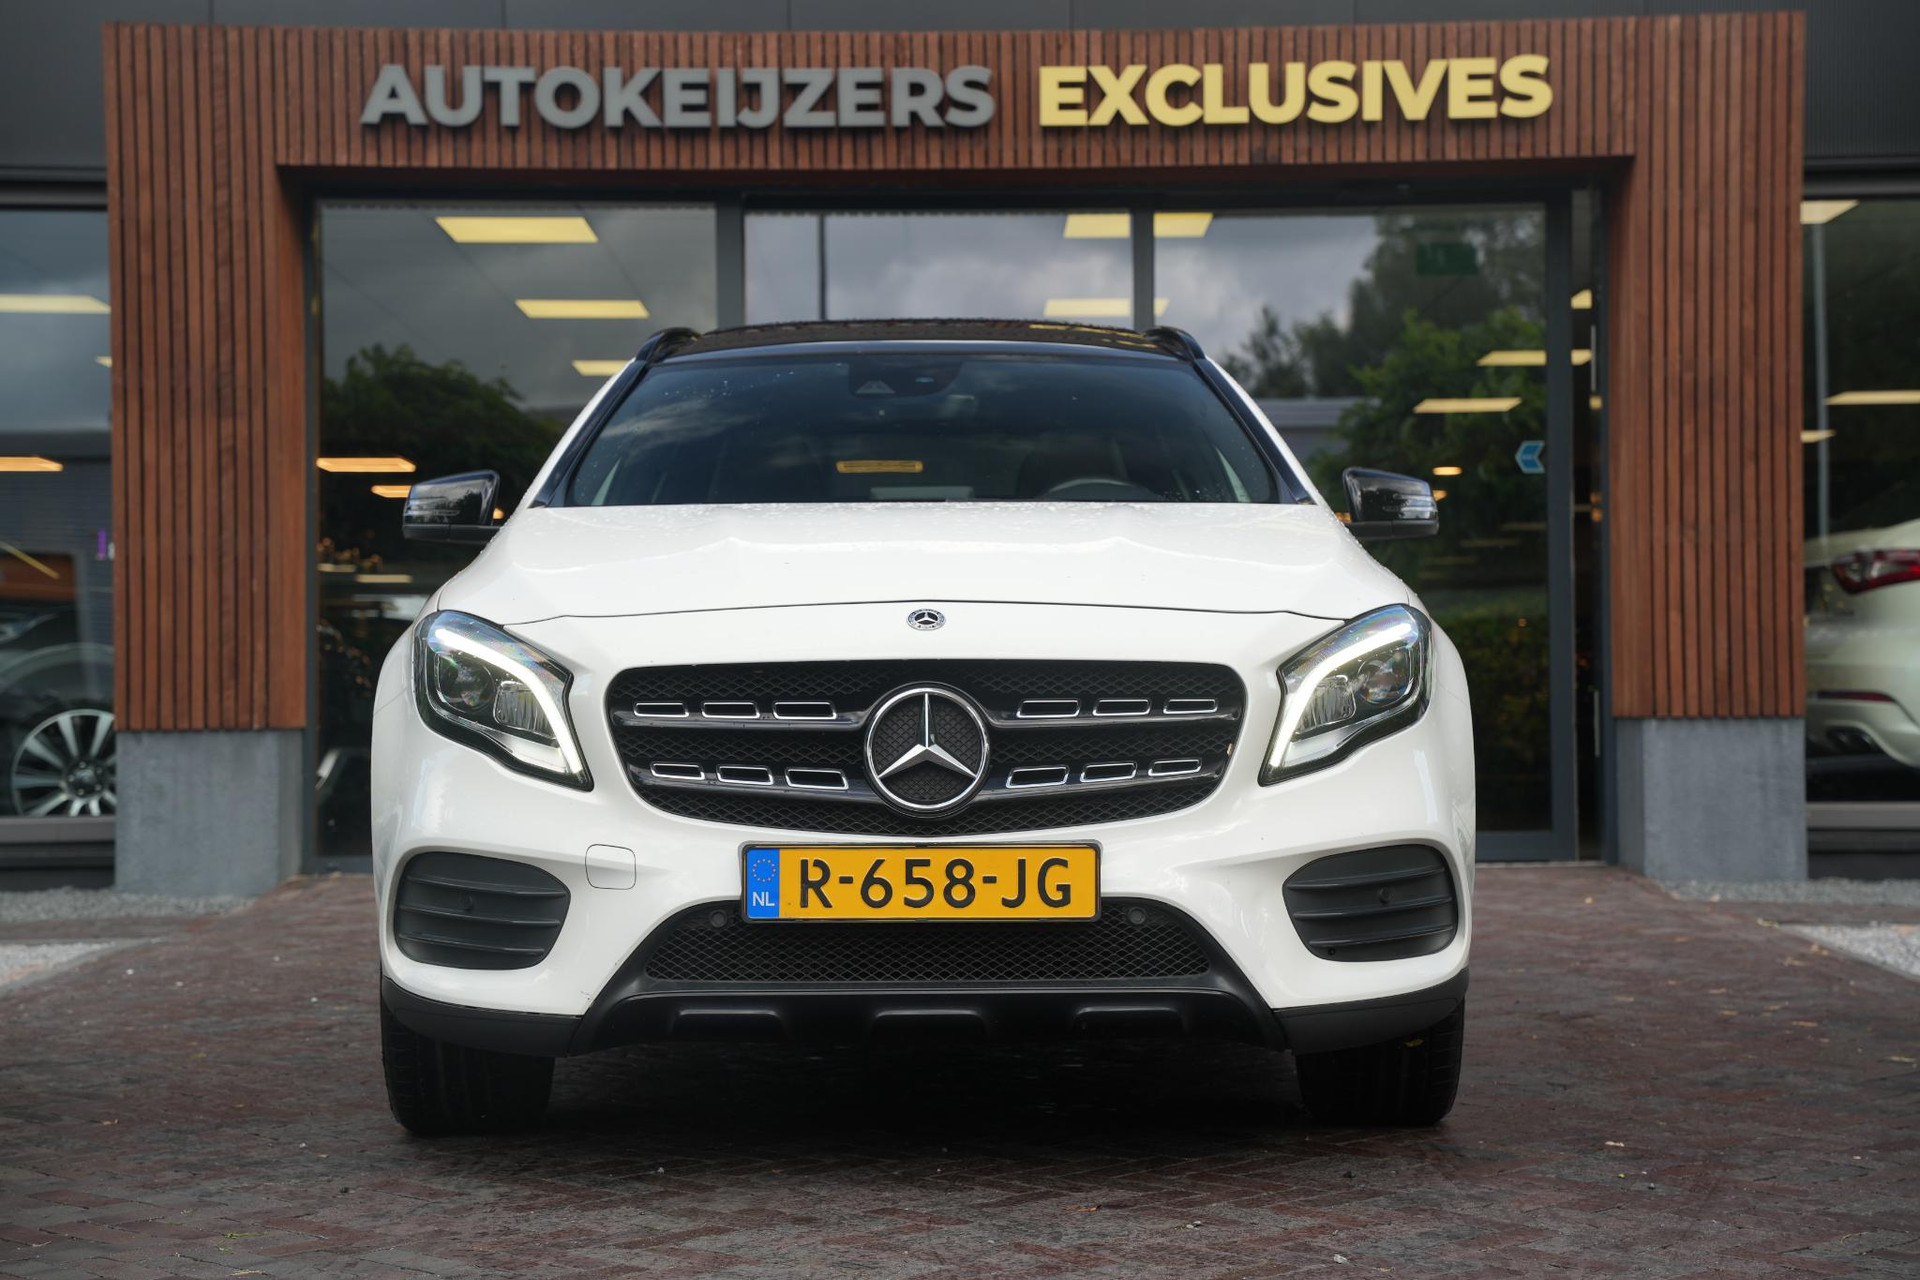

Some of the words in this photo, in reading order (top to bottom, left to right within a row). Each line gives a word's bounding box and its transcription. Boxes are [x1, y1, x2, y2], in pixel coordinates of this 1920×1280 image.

[361, 64, 995, 129] AUTOKEIJZERS
[1039, 54, 1553, 127] EXCLUSIVES
[752, 891, 775, 907] NL
[799, 857, 1072, 909] R-658-JG
